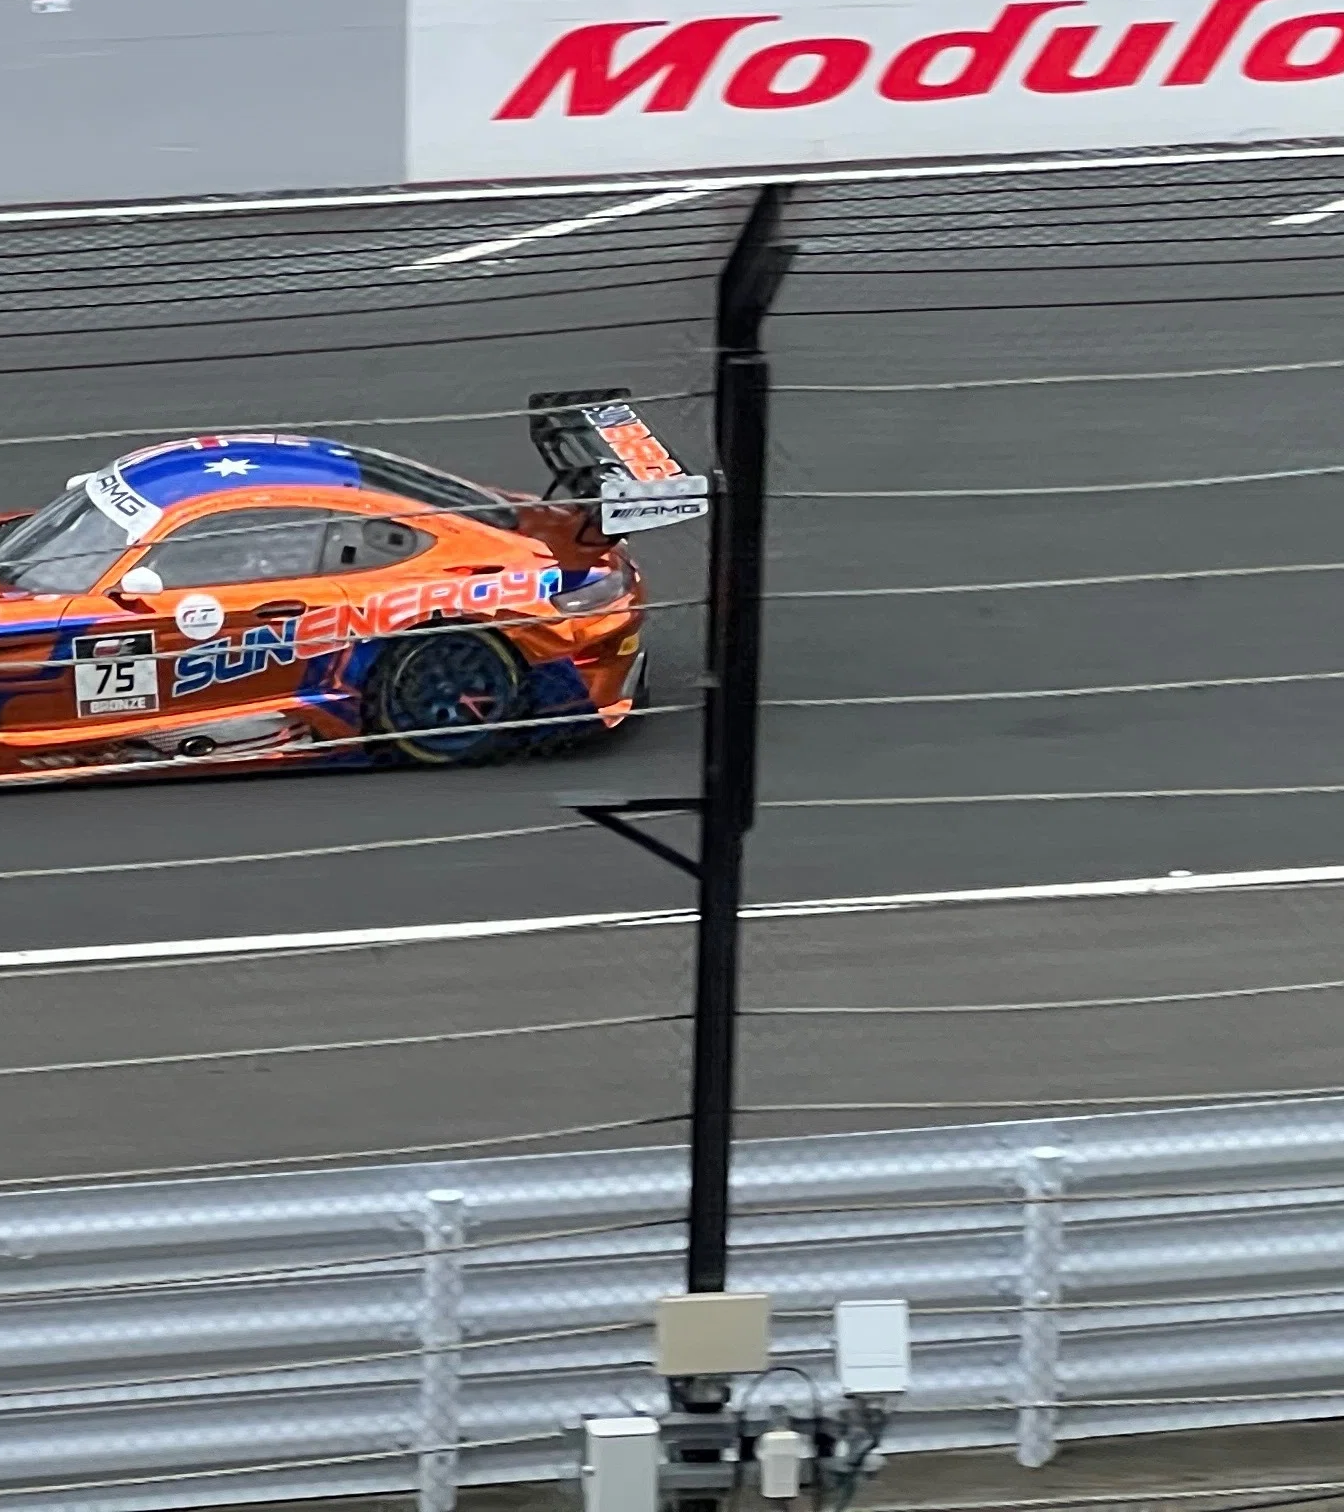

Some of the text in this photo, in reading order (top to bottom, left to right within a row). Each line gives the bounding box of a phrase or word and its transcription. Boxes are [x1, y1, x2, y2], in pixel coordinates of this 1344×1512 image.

[96, 475, 146, 516] AMG
[639, 504, 700, 517] AMG
[96, 662, 134, 696] 75
[90, 697, 146, 713] BRONZE
